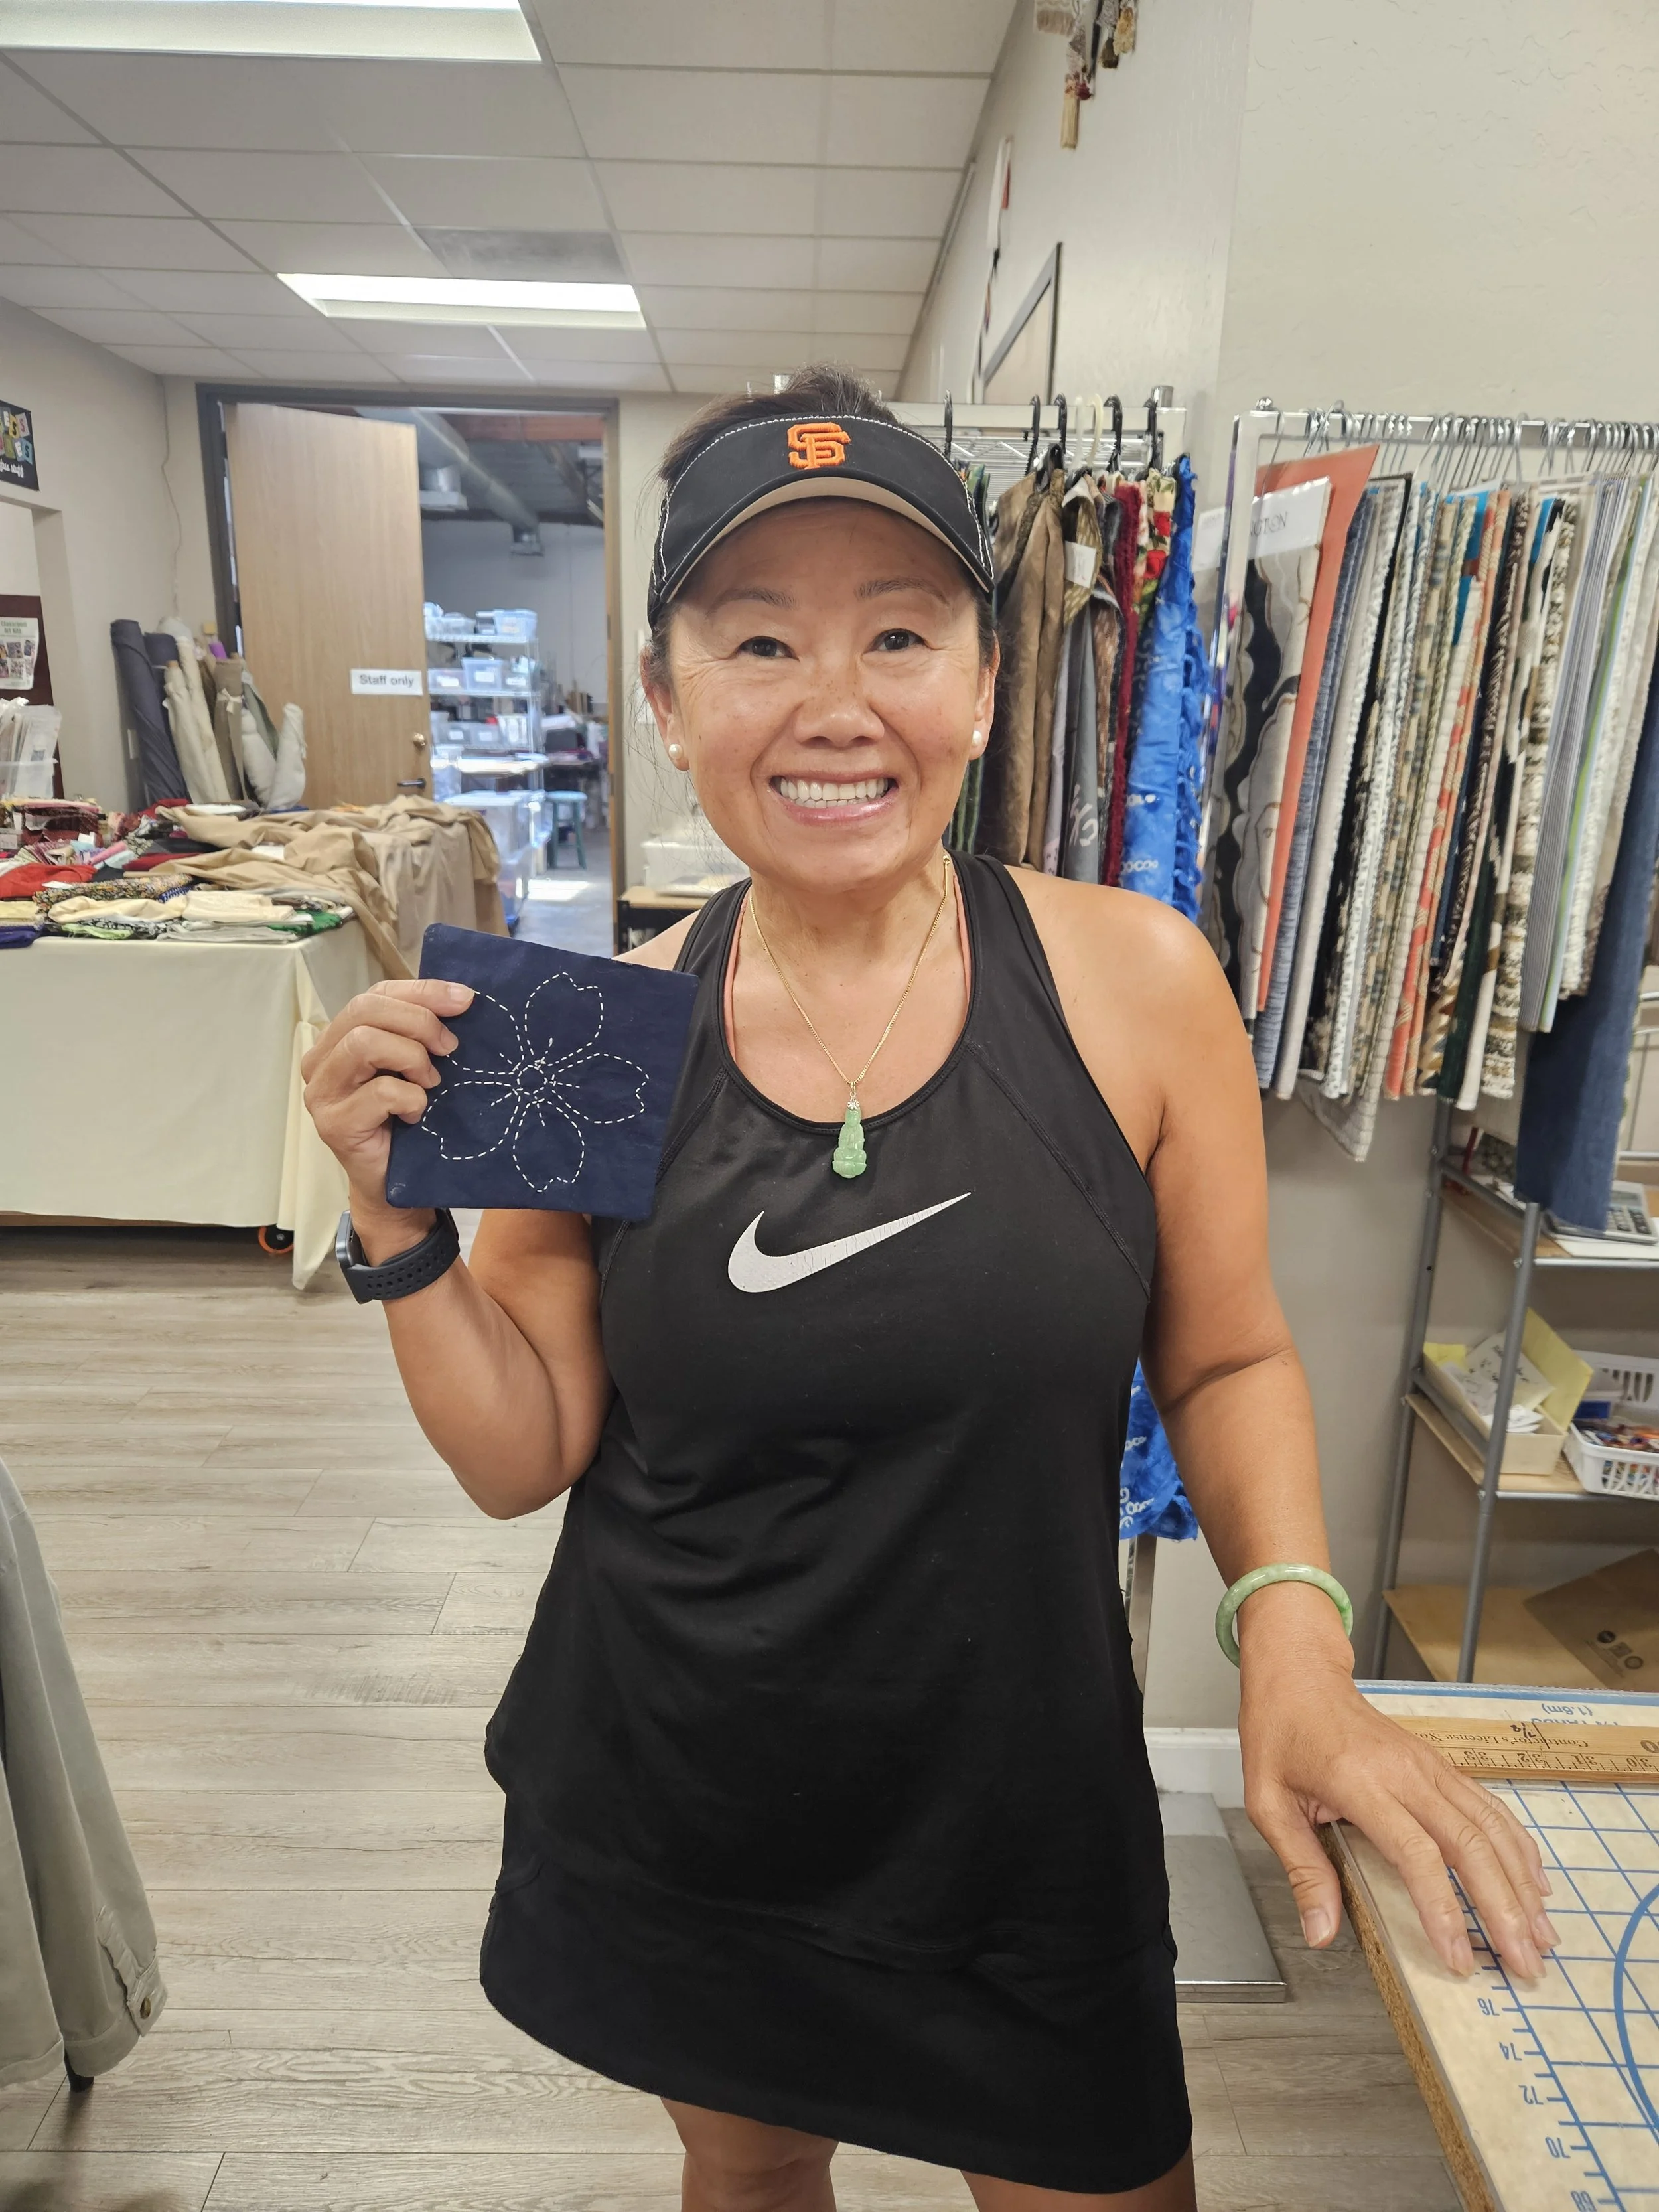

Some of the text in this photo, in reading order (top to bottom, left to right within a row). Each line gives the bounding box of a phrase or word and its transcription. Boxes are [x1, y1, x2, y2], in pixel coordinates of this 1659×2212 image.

[787, 422, 851, 470] SF
[359, 673, 414, 688] Staff only
[1542, 1703, 1593, 1716] (1.6m)
[1415, 1732, 1589, 1748] Contractor's License No.
[1477, 1998, 1500, 2016] 76
[1499, 2041, 1522, 2061] 74
[1518, 2084, 1544, 2105] 72
[1545, 2136, 1571, 2158] 70
